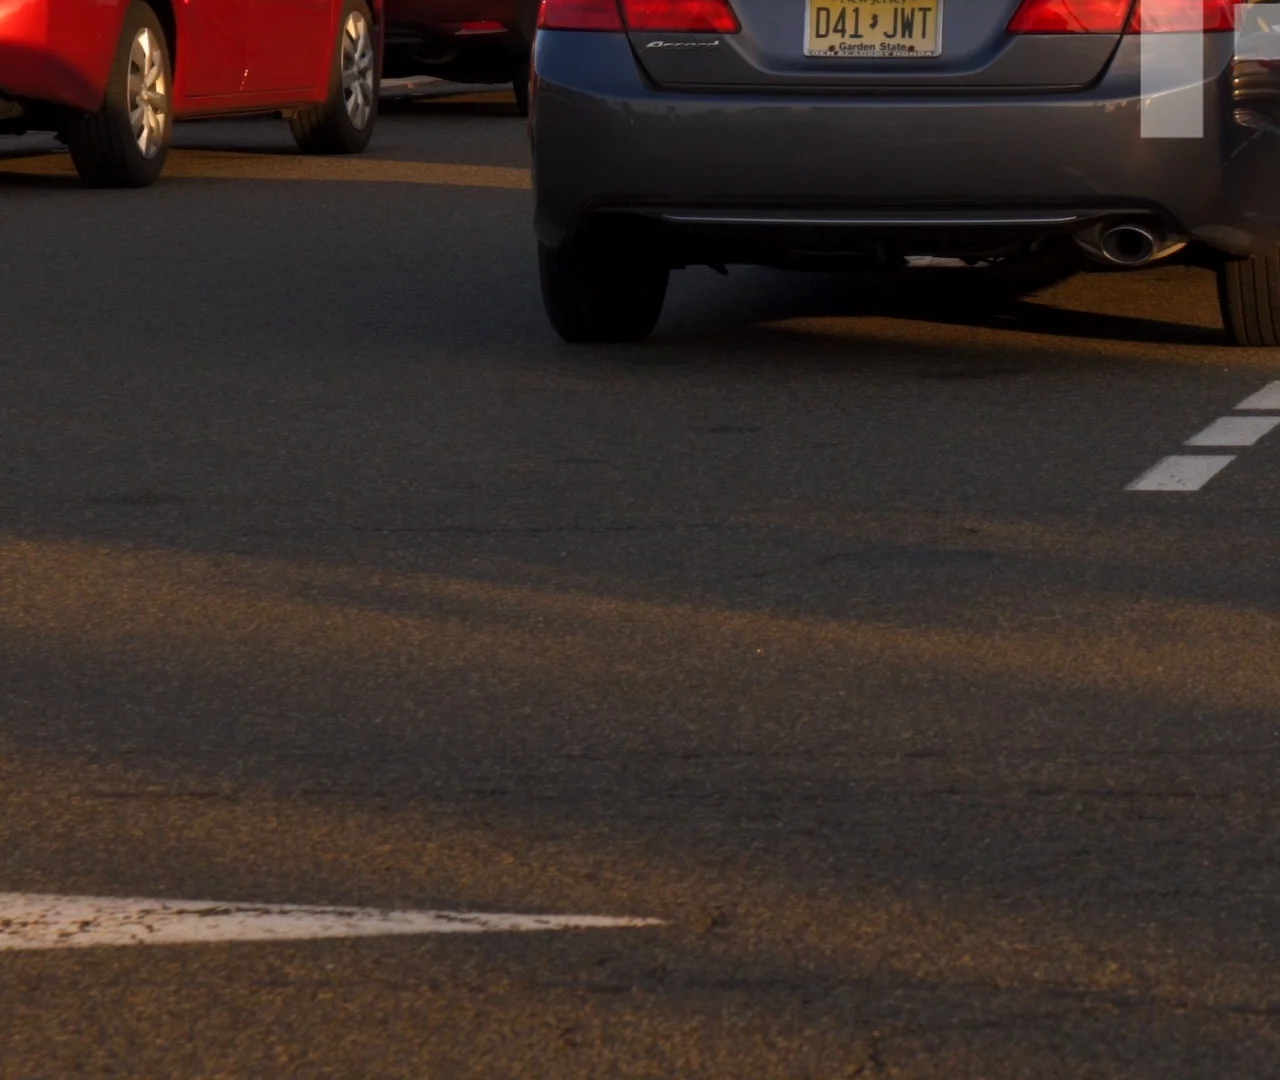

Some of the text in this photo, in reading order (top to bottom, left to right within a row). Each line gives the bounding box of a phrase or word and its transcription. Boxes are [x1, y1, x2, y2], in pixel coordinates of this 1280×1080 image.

[815, 7, 932, 39] D41 JWT
[839, 42, 907, 51] Garden State
